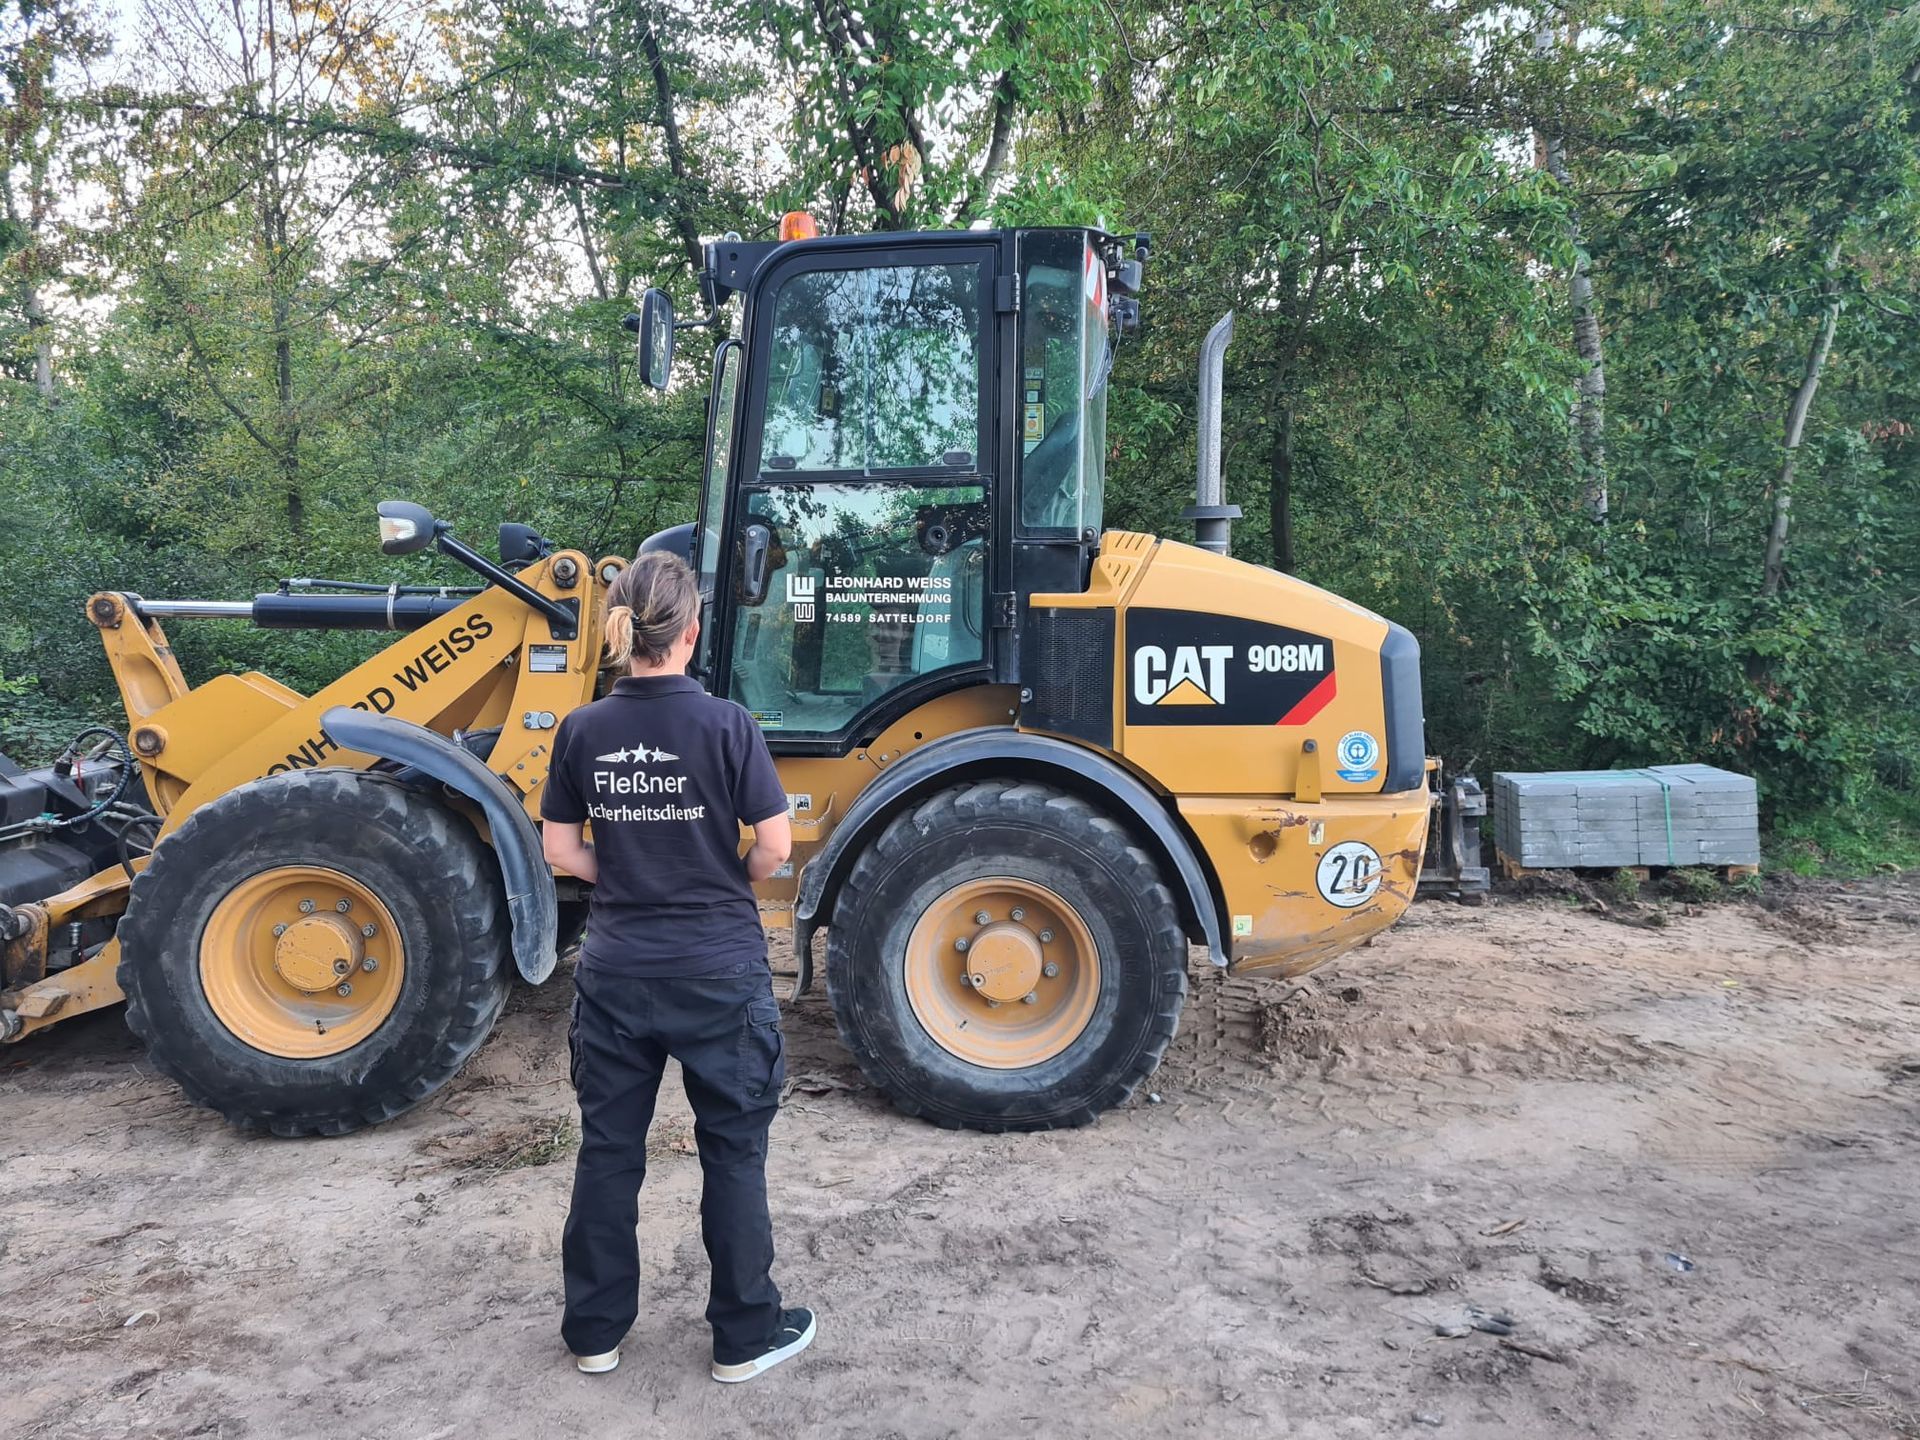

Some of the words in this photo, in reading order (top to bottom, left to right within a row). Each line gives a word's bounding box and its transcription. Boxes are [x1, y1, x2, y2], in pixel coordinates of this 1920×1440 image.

[825, 577, 904, 589] LEONHARD
[907, 577, 952, 589] WEISS
[825, 593, 952, 604] BAUUNTERNEHMUNG
[825, 613, 861, 623] 74589
[868, 613, 952, 624] SATTELDORF
[393, 613, 494, 692] WEISS
[1134, 645, 1234, 705] CAT
[1247, 644, 1324, 673] 908M
[593, 771, 687, 794] Fleßner
[588, 803, 706, 822] icherheitsdienst
[1329, 855, 1370, 894] 20
